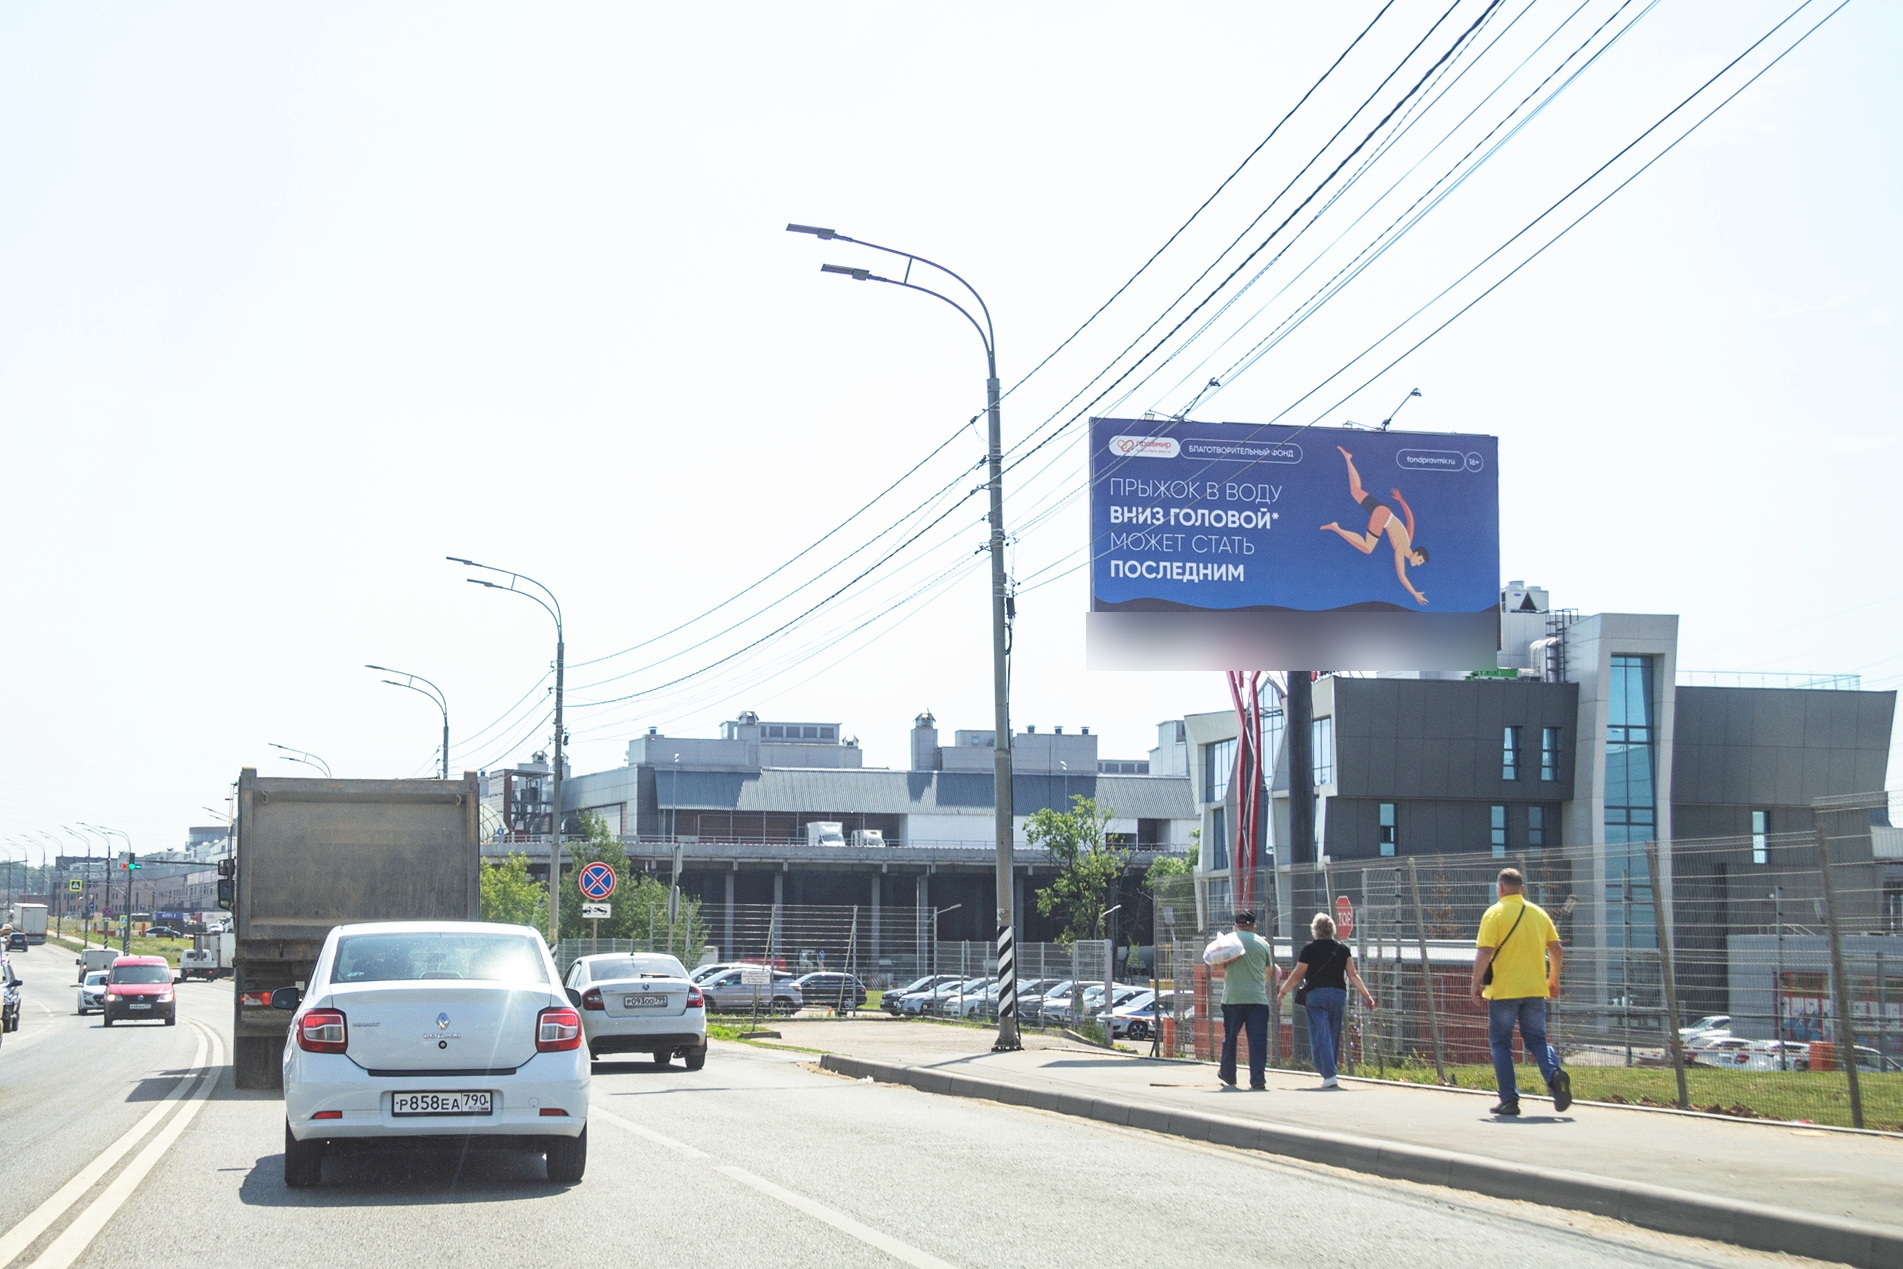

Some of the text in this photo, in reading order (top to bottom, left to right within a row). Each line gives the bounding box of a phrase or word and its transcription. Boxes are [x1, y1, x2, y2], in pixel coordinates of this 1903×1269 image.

[1189, 444, 1294, 458] БЛАГОТВОРИТЕЛЬНЫЙ ФОНД
[1406, 456, 1456, 465] fondpravmir.ru
[1468, 458, 1480, 466] 16+
[1110, 478, 1282, 505] ПРЫЖОК В ВОДУ
[1110, 506, 1164, 526] ВНИЗ
[1110, 533, 1255, 555] МОЖЕТ СТАТЬ
[1110, 560, 1245, 583] ПОСЛЕДНИМ
[463, 1094, 487, 1106] 790
